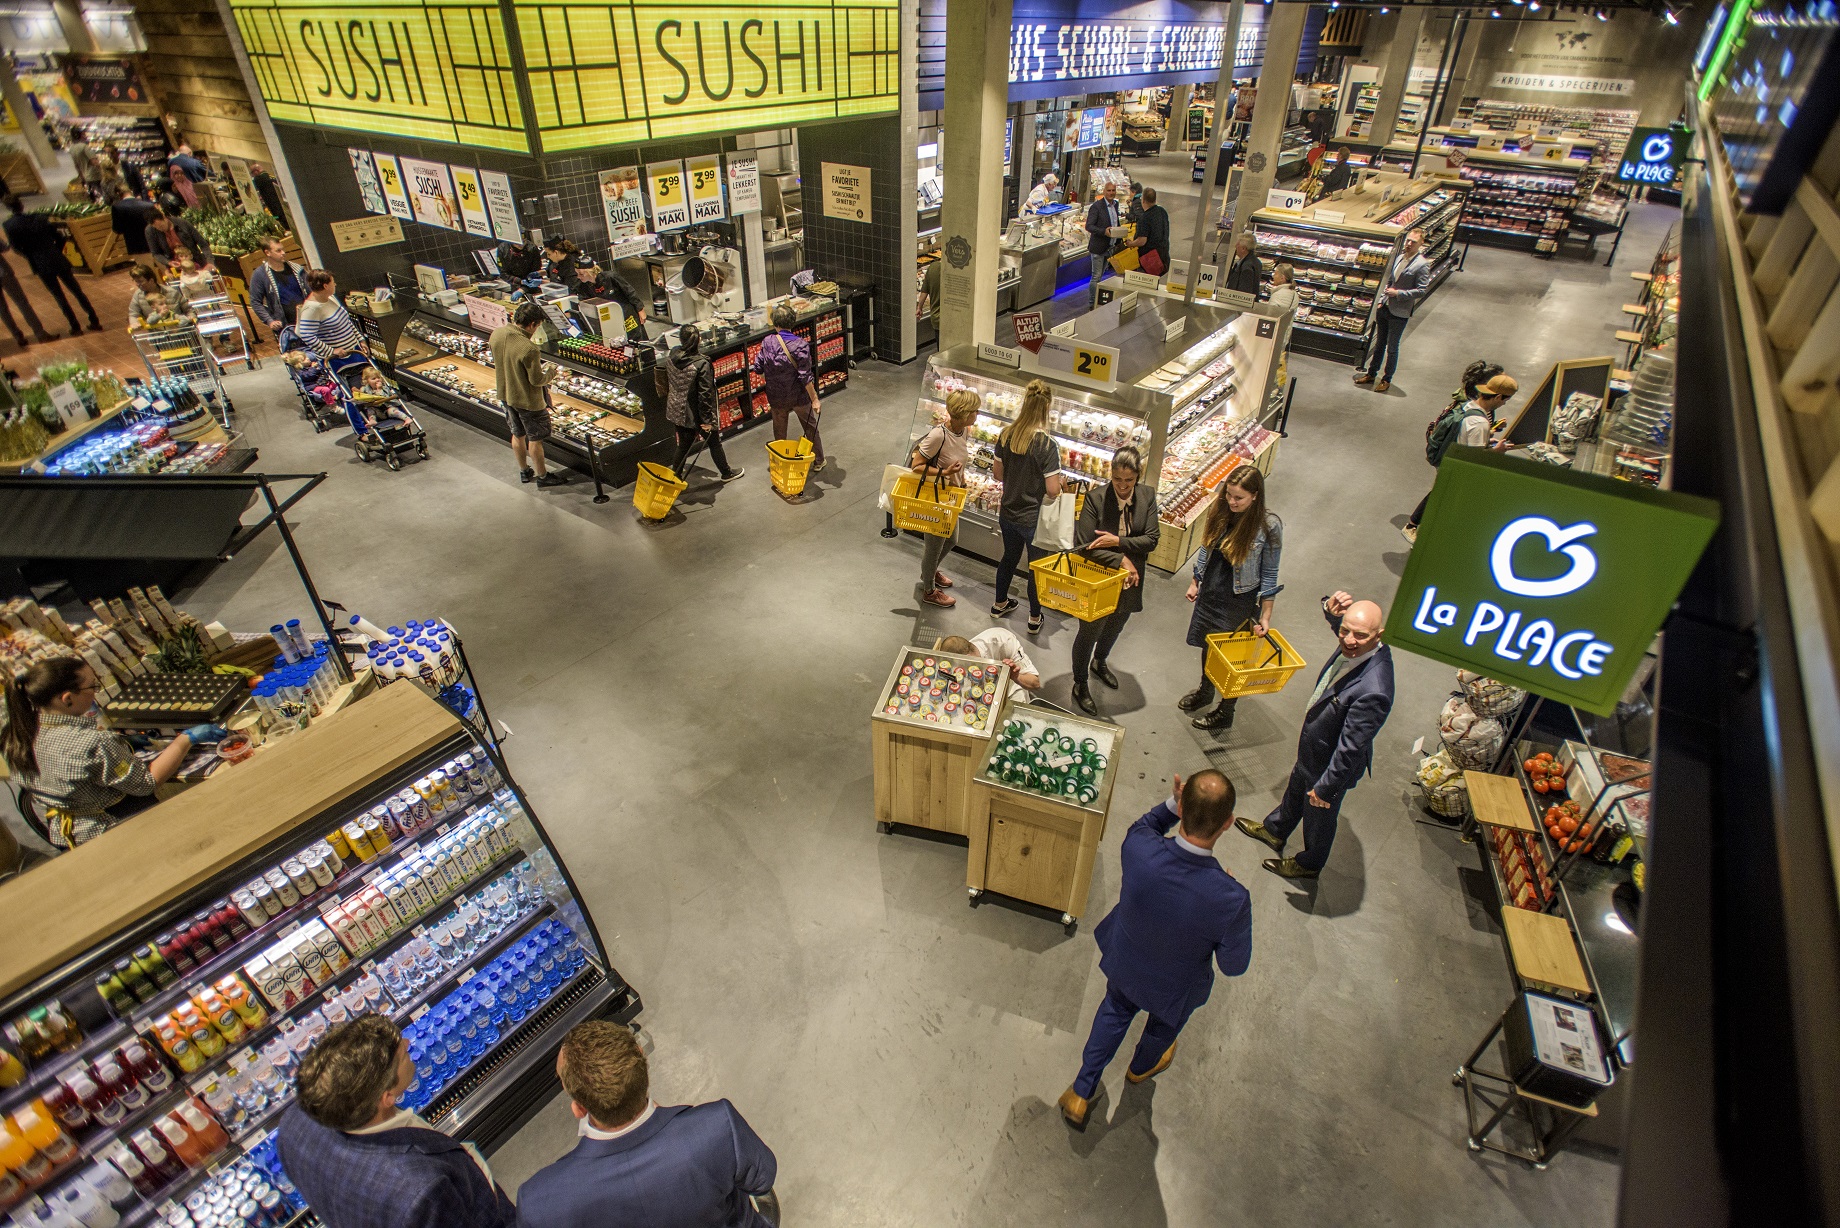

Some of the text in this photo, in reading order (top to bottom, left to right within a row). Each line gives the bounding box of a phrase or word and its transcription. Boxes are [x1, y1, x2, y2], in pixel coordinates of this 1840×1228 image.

[1007, 24, 1047, 83] VIS
[299, 18, 429, 107] SUSHI
[655, 19, 823, 105] SUSHI
[738, 157, 756, 168] SUSHI
[1621, 162, 1674, 181] La PLACE
[415, 175, 444, 198] SUSHI
[732, 178, 757, 190] LEKKERST
[831, 175, 860, 187] FAVORIETE
[609, 197, 638, 210] SPICY BEEF
[694, 200, 720, 208] CALIFORNIA
[610, 205, 641, 224] SUSHI
[695, 205, 721, 218] MAKI
[658, 211, 686, 227] MAKI
[1015, 315, 1040, 326] ALTIJD
[1019, 332, 1042, 342] PRIJS
[984, 346, 1013, 360] GOOD TO GO
[910, 511, 941, 523] JUMBO
[1048, 586, 1077, 601] JUMBO
[1412, 585, 1615, 680] La PLACE
[402, 810, 412, 828] fristi
[323, 942, 339, 956] Vifit
[304, 953, 320, 967] Vifit
[285, 967, 301, 981] Vifit
[267, 980, 283, 993] Vifit
